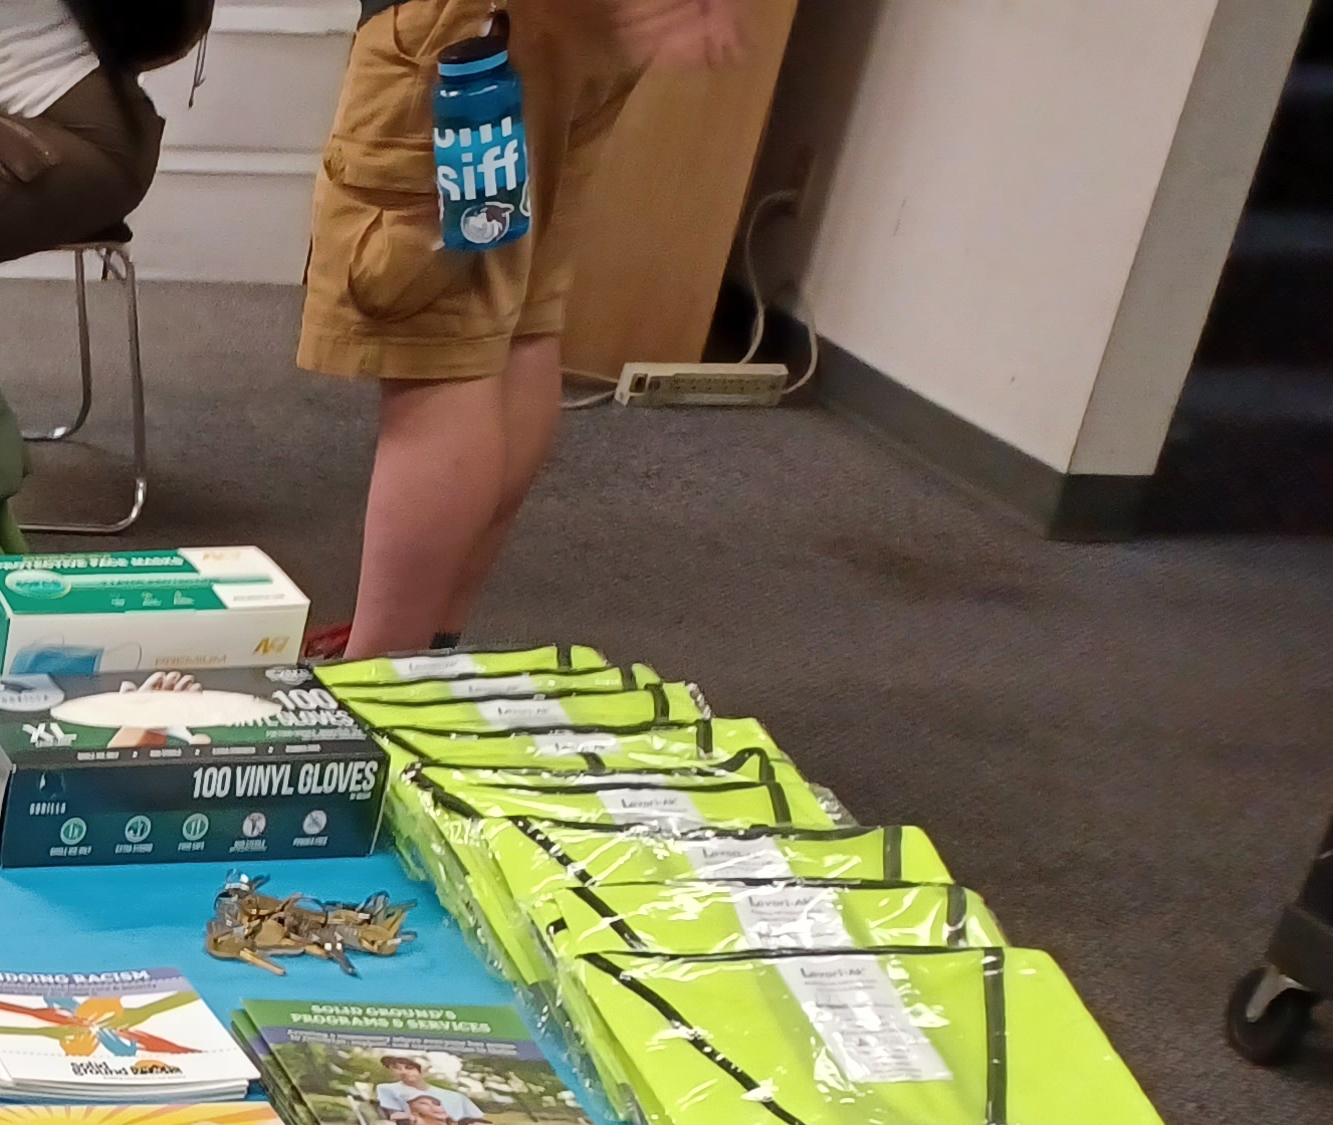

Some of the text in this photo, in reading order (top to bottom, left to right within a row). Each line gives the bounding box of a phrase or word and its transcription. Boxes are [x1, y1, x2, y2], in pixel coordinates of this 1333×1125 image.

[438, 139, 519, 201] siff
[273, 688, 338, 710] 100
[193, 760, 378, 799] 100 VINYL GLOVES
[72, 970, 150, 983] RACISM
